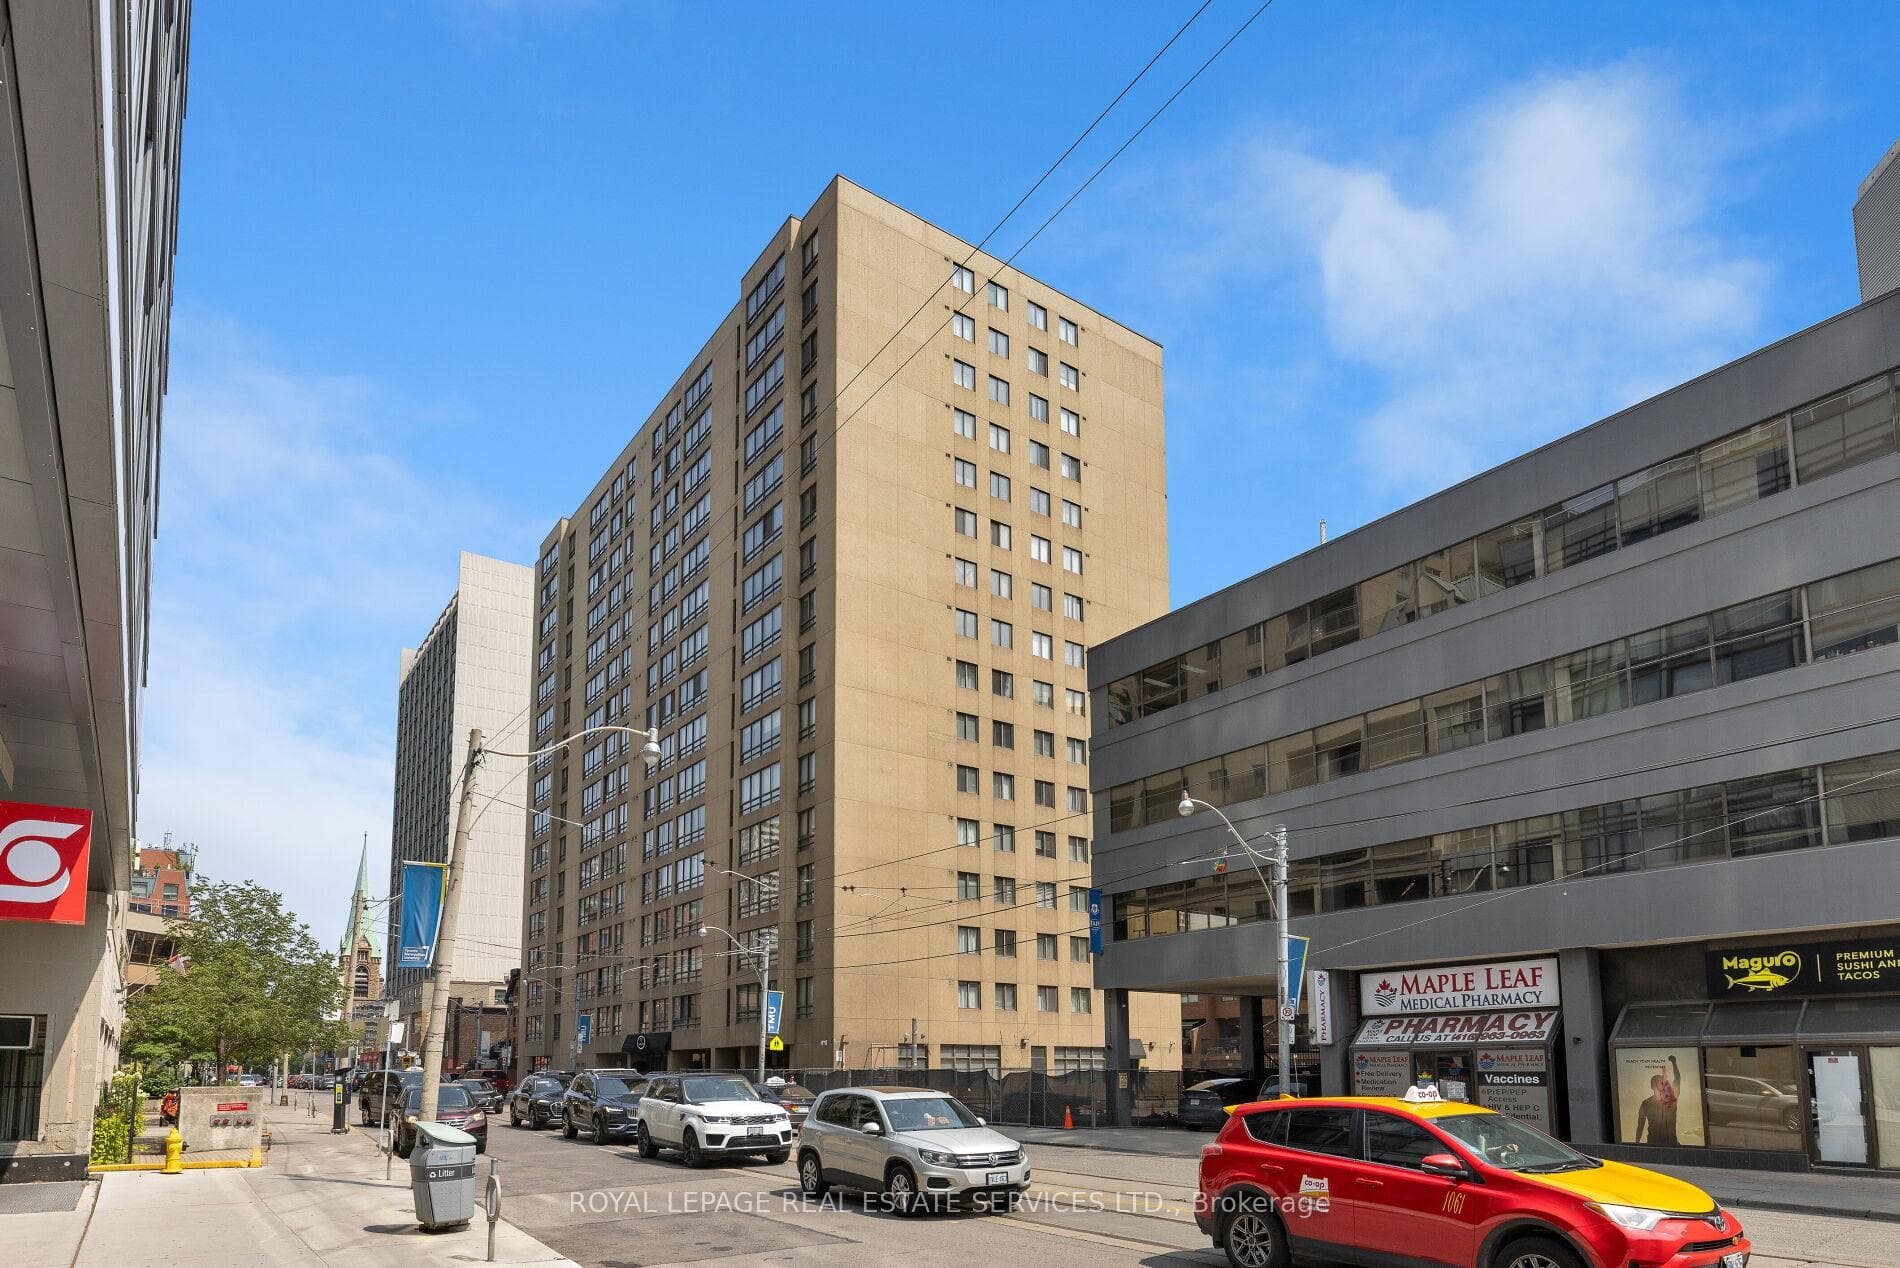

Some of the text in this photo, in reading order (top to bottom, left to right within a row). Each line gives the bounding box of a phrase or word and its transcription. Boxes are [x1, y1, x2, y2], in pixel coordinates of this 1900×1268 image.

[1836, 950, 1894, 961] PREMIUM
[1722, 953, 1797, 971] Maguro
[1837, 961, 1874, 971] SUSHI
[1838, 971, 1880, 981] TACOS
[1400, 967, 1543, 996] MAPLE LEAF
[1400, 991, 1543, 1011] MEDICAL PHARMACY
[768, 1006, 776, 1030] TMU
[1384, 1012, 1554, 1035] PHARMACY
[1417, 1034, 1432, 1042] US
[1370, 1055, 1391, 1063] MAPLE
[1497, 1054, 1544, 1062] MAPLE LEAF
[1376, 1070, 1402, 1078] Delivery
[1485, 1074, 1540, 1084] Vaccines
[1418, 1090, 1438, 1100] co-op
[1487, 1103, 1502, 1111] HIV
[438, 1169, 455, 1178] Litter
[1304, 1179, 1325, 1189] co-op
[1443, 1190, 1466, 1215] 1061
